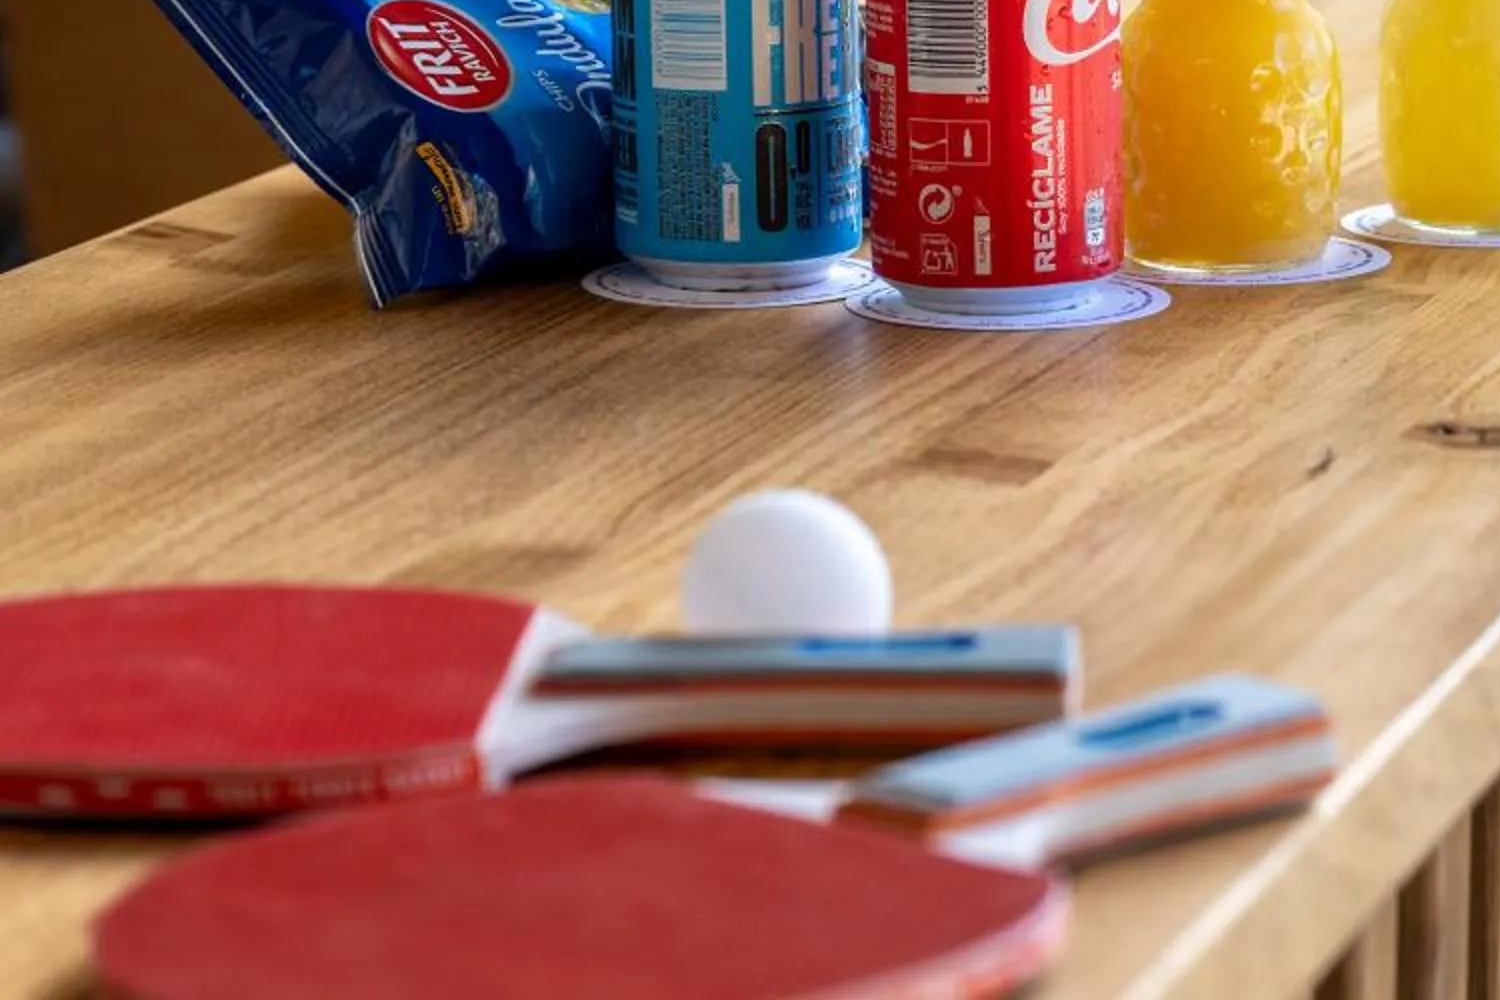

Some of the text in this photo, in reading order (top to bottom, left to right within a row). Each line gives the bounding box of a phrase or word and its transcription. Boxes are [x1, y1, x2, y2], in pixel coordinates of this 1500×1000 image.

[378, 16, 480, 95] FRIT
[429, 21, 497, 82] RAVICH
[531, 69, 575, 113] CHIPS
